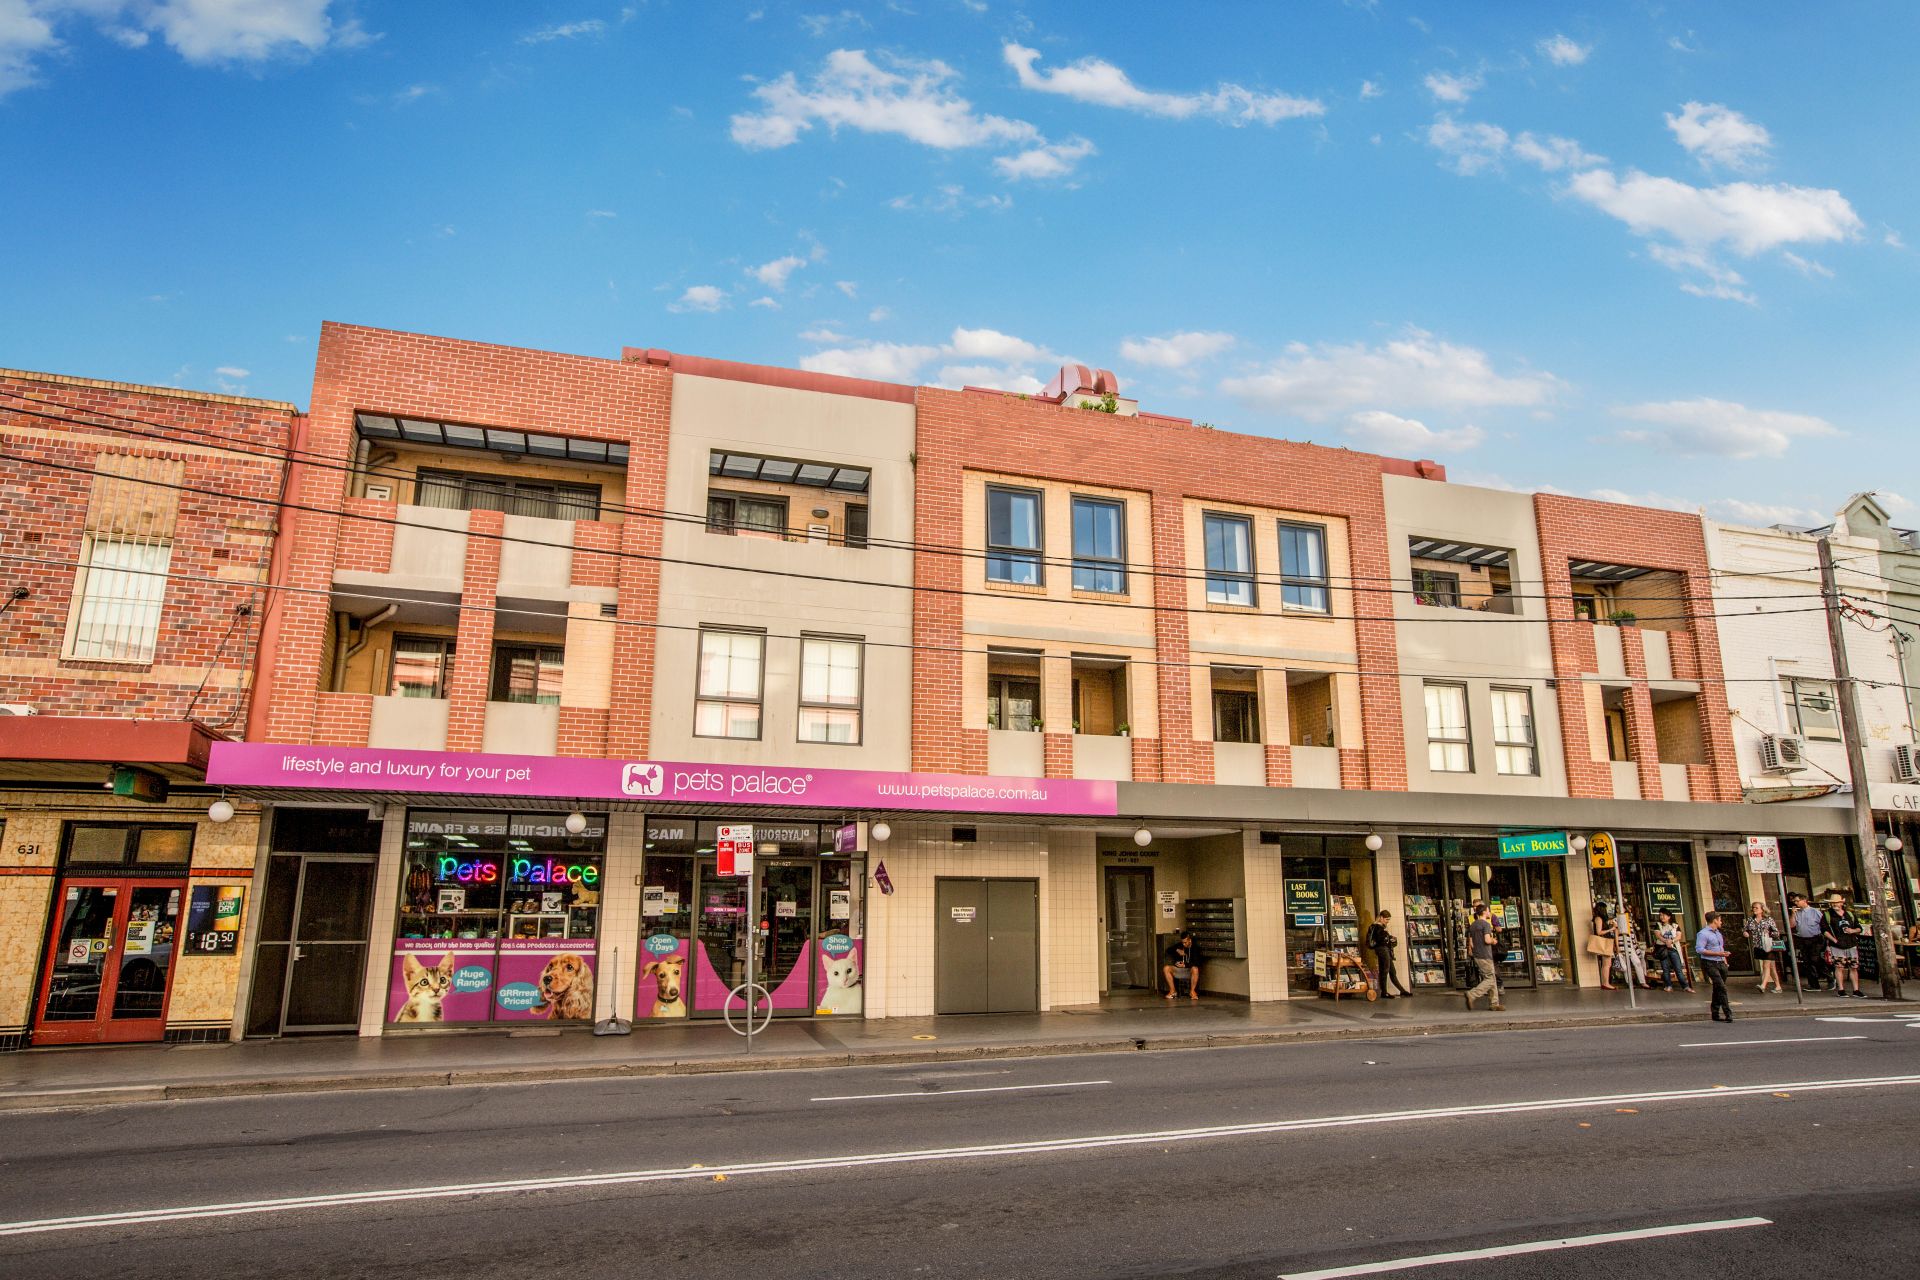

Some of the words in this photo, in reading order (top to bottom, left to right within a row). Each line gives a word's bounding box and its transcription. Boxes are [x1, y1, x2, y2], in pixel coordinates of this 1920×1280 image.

[282, 755, 344, 774] lifestyle
[349, 757, 381, 775] and
[386, 759, 435, 780] luxury
[440, 761, 461, 777] for
[465, 765, 501, 782] your
[505, 765, 531, 782] pet
[674, 769, 724, 795] pets
[878, 783, 1048, 801] www.petspalace.com.au
[17, 844, 40, 855] 631
[1502, 842, 1526, 854] LAST
[1530, 839, 1565, 851] BOOKS
[439, 855, 497, 882] Pets
[513, 857, 598, 883] Palace
[1291, 883, 1307, 891] LAST
[1652, 886, 1666, 894] LAST
[1657, 893, 1676, 901] BOOKS
[652, 936, 672, 945] Open
[828, 936, 848, 945] Shop
[656, 943, 675, 952] Days
[826, 943, 849, 951] Online
[460, 969, 485, 980] Huge
[457, 977, 489, 988] Range!
[504, 996, 533, 1005] Prices!
